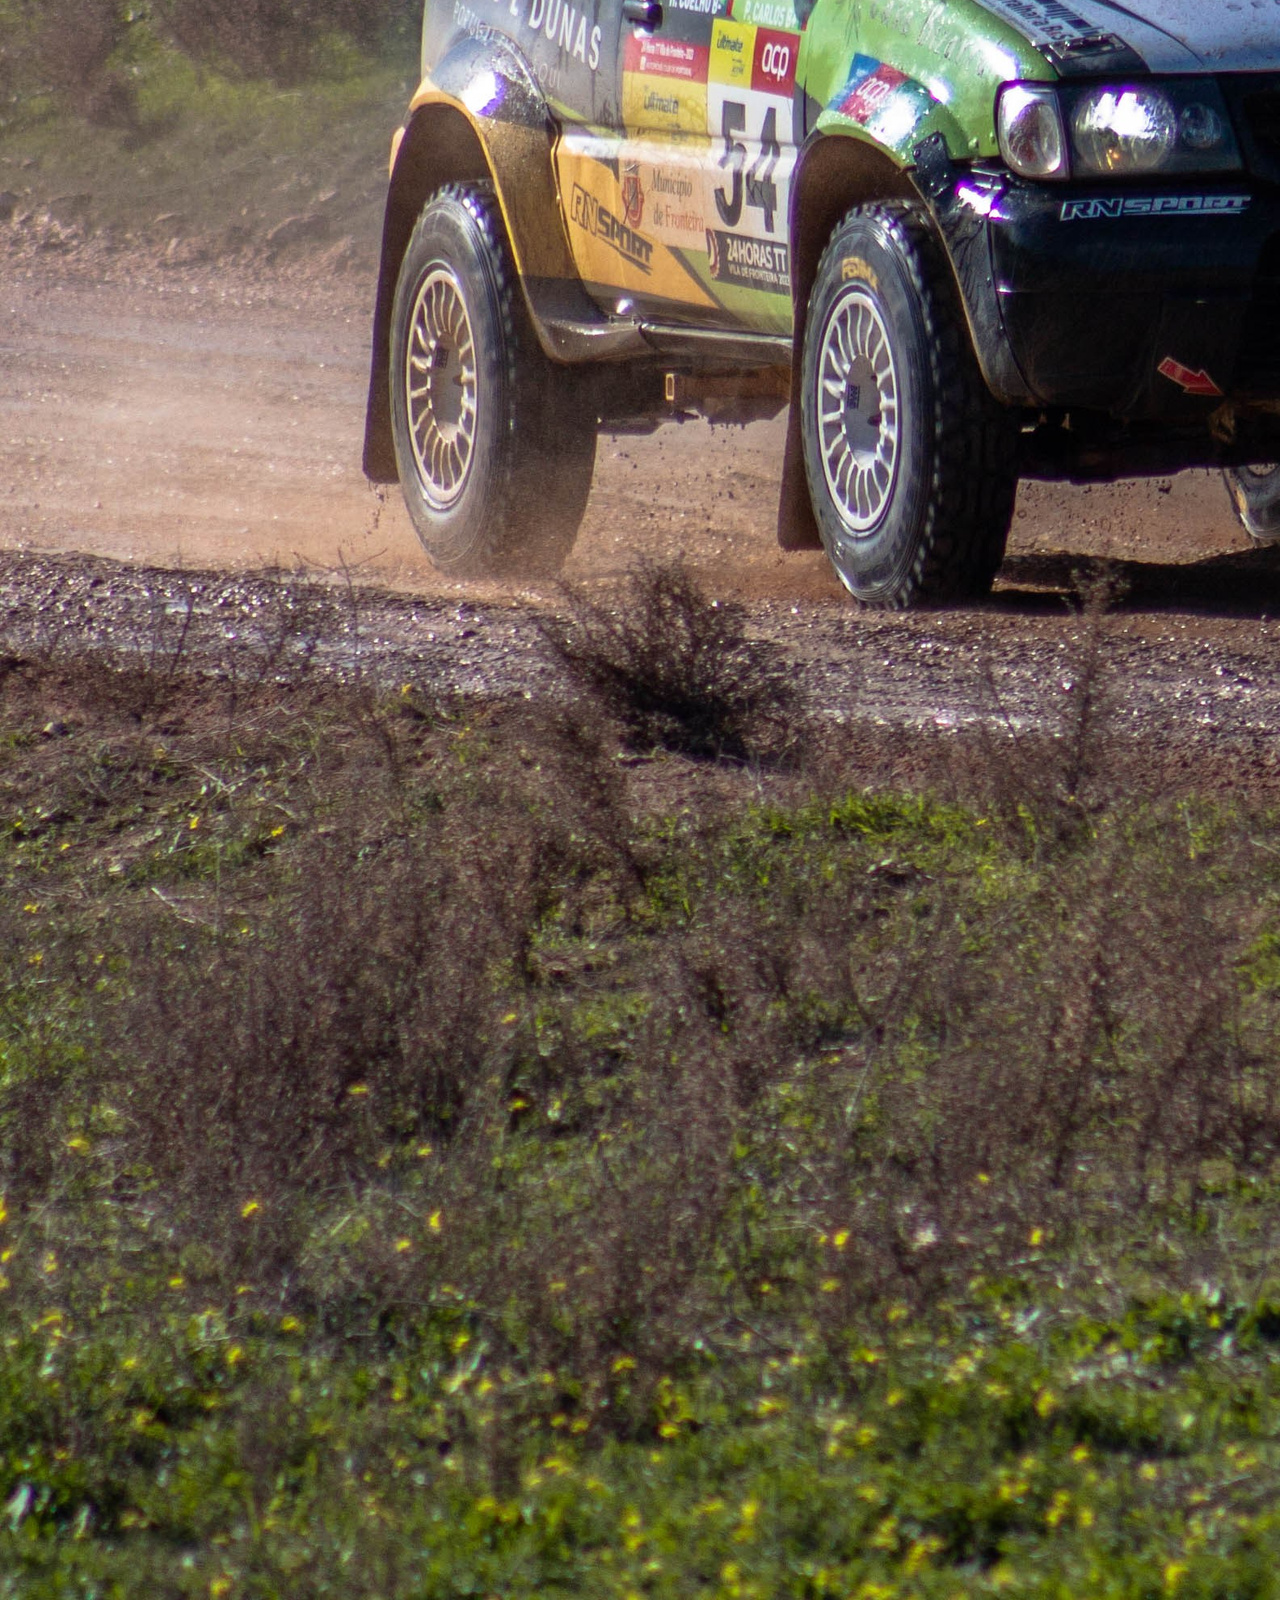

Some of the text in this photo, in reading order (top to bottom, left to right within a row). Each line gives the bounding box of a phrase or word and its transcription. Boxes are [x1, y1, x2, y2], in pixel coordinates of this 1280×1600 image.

[752, 1, 786, 27] CARLOS
[761, 42, 790, 82] acp
[713, 99, 781, 234] 54
[653, 202, 705, 233] de Fronteira
[773, 247, 787, 273] TT
